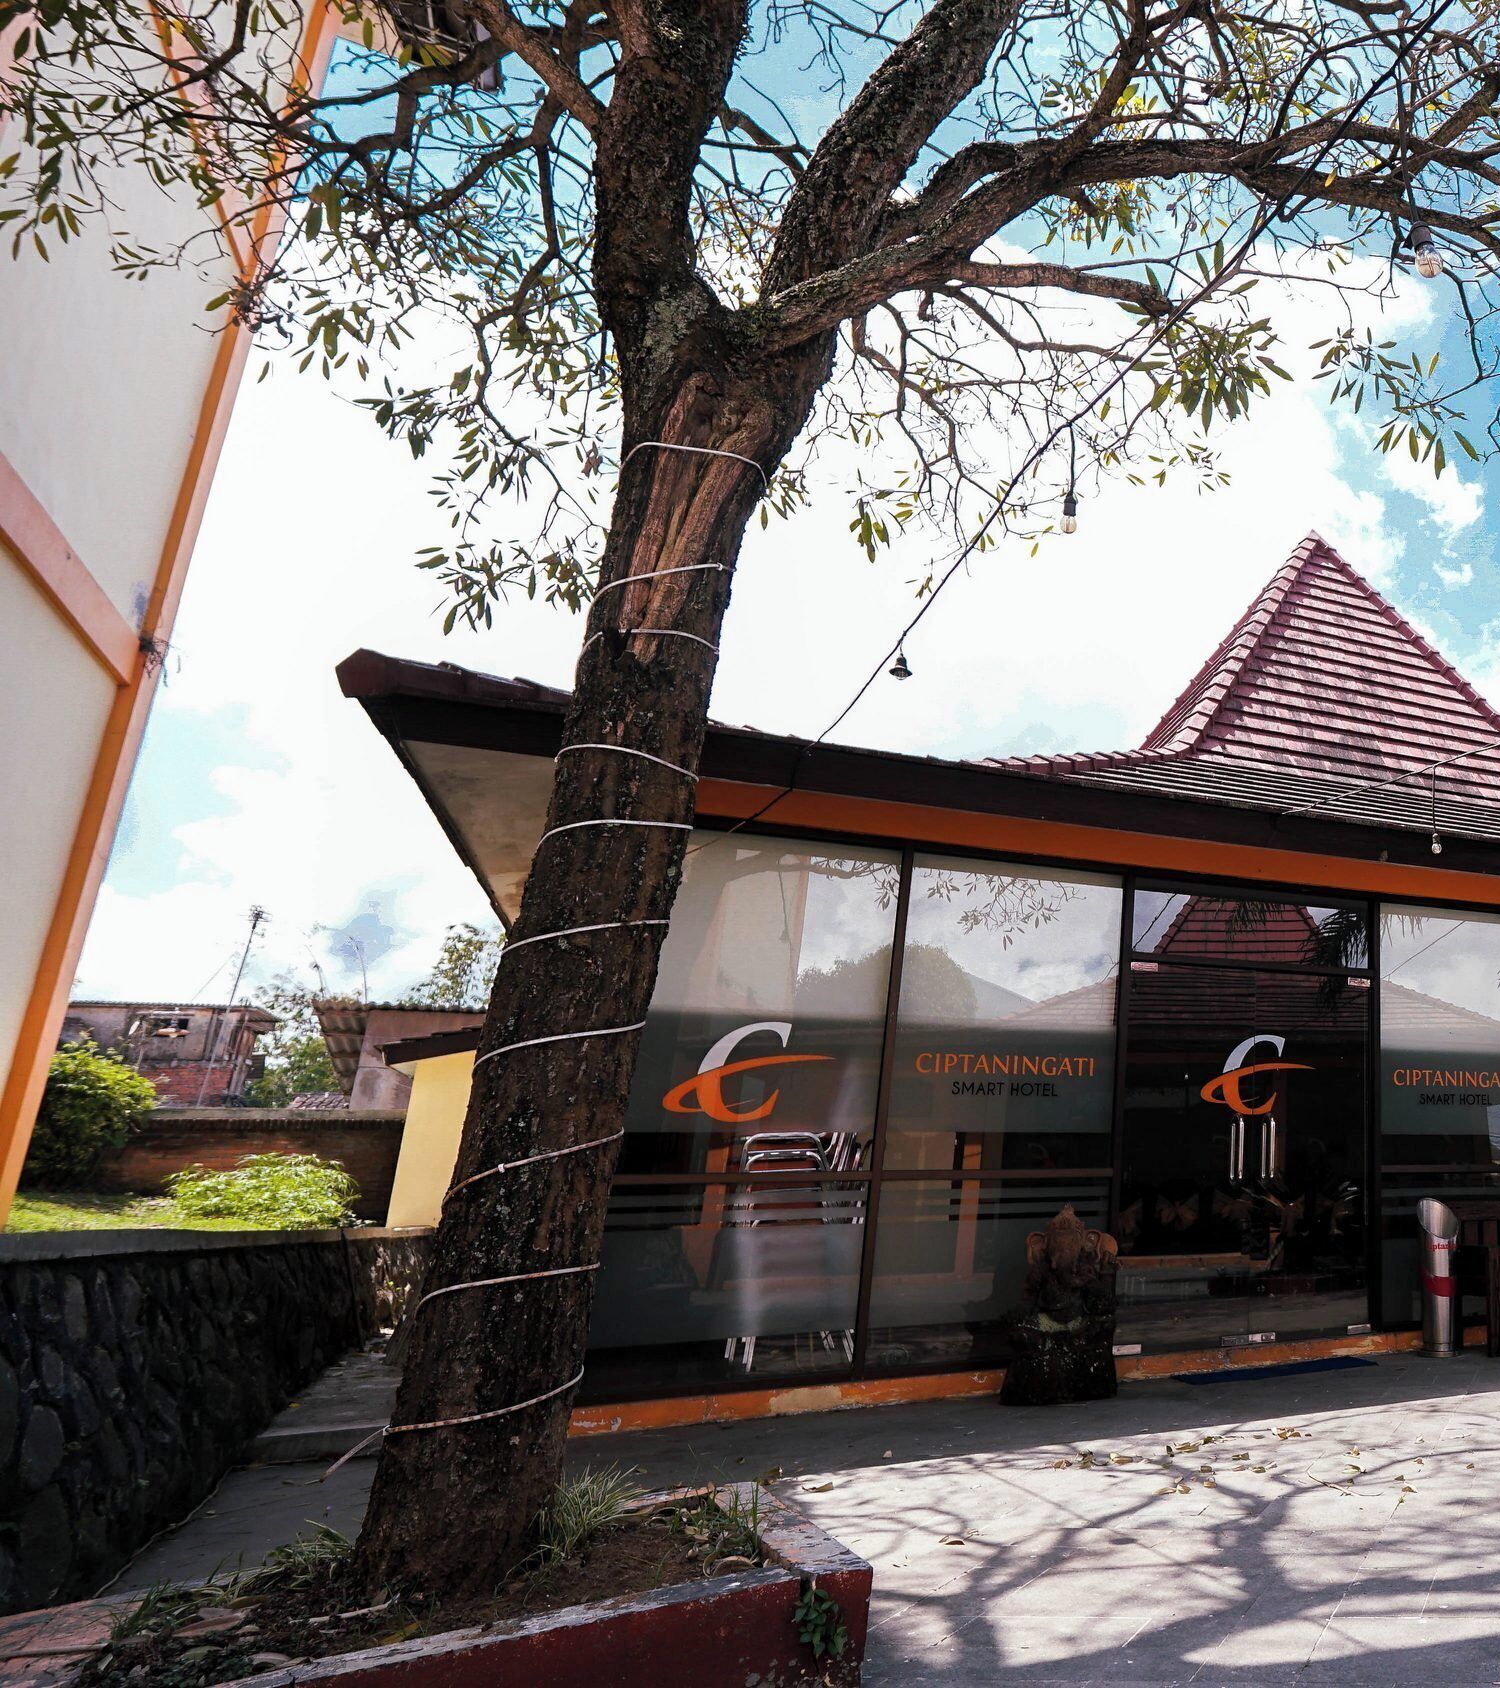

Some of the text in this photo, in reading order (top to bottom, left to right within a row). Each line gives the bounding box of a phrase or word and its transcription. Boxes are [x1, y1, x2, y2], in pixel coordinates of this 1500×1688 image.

[915, 1052, 1095, 1077] CIPTANINGATI
[951, 1081, 1058, 1097] SMART HOTEL
[1419, 1093, 1492, 1106] SMART HOTEL
